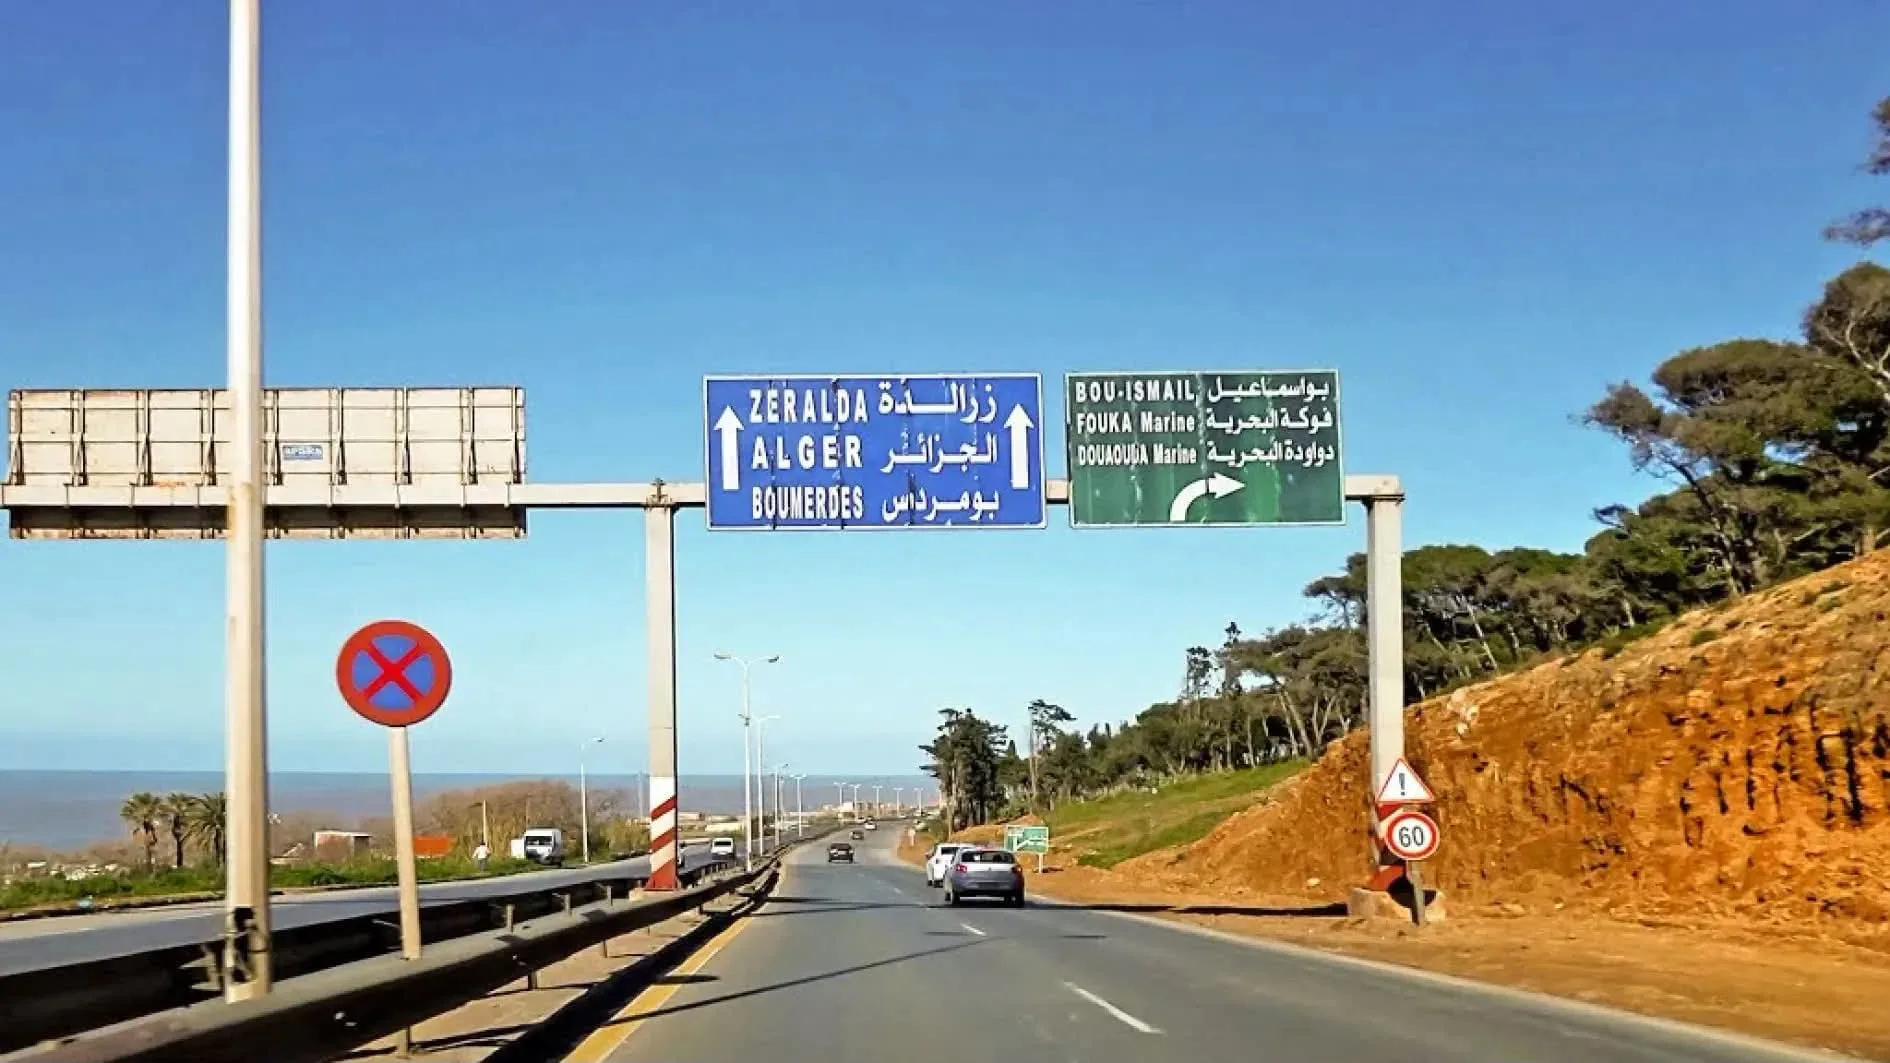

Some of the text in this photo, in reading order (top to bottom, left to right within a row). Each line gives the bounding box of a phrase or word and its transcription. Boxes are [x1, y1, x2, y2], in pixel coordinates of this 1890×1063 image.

[749, 388, 869, 424] ZERALDA
[878, 380, 998, 424] زرالدة
[1075, 379, 1195, 403] BOU-ISMAIL
[1077, 410, 1195, 434] FOUKA Marine
[1206, 405, 1333, 434] فوكة البحرية
[751, 435, 863, 470] ALGER
[879, 431, 998, 473] الجزائر
[1077, 443, 1197, 466] DOUAOUDA Marine
[1206, 440, 1335, 467] دواودة البحرية
[752, 485, 863, 520] BOUMERDES
[881, 487, 1000, 522] بومرداس
[1399, 826, 1424, 847] 60
